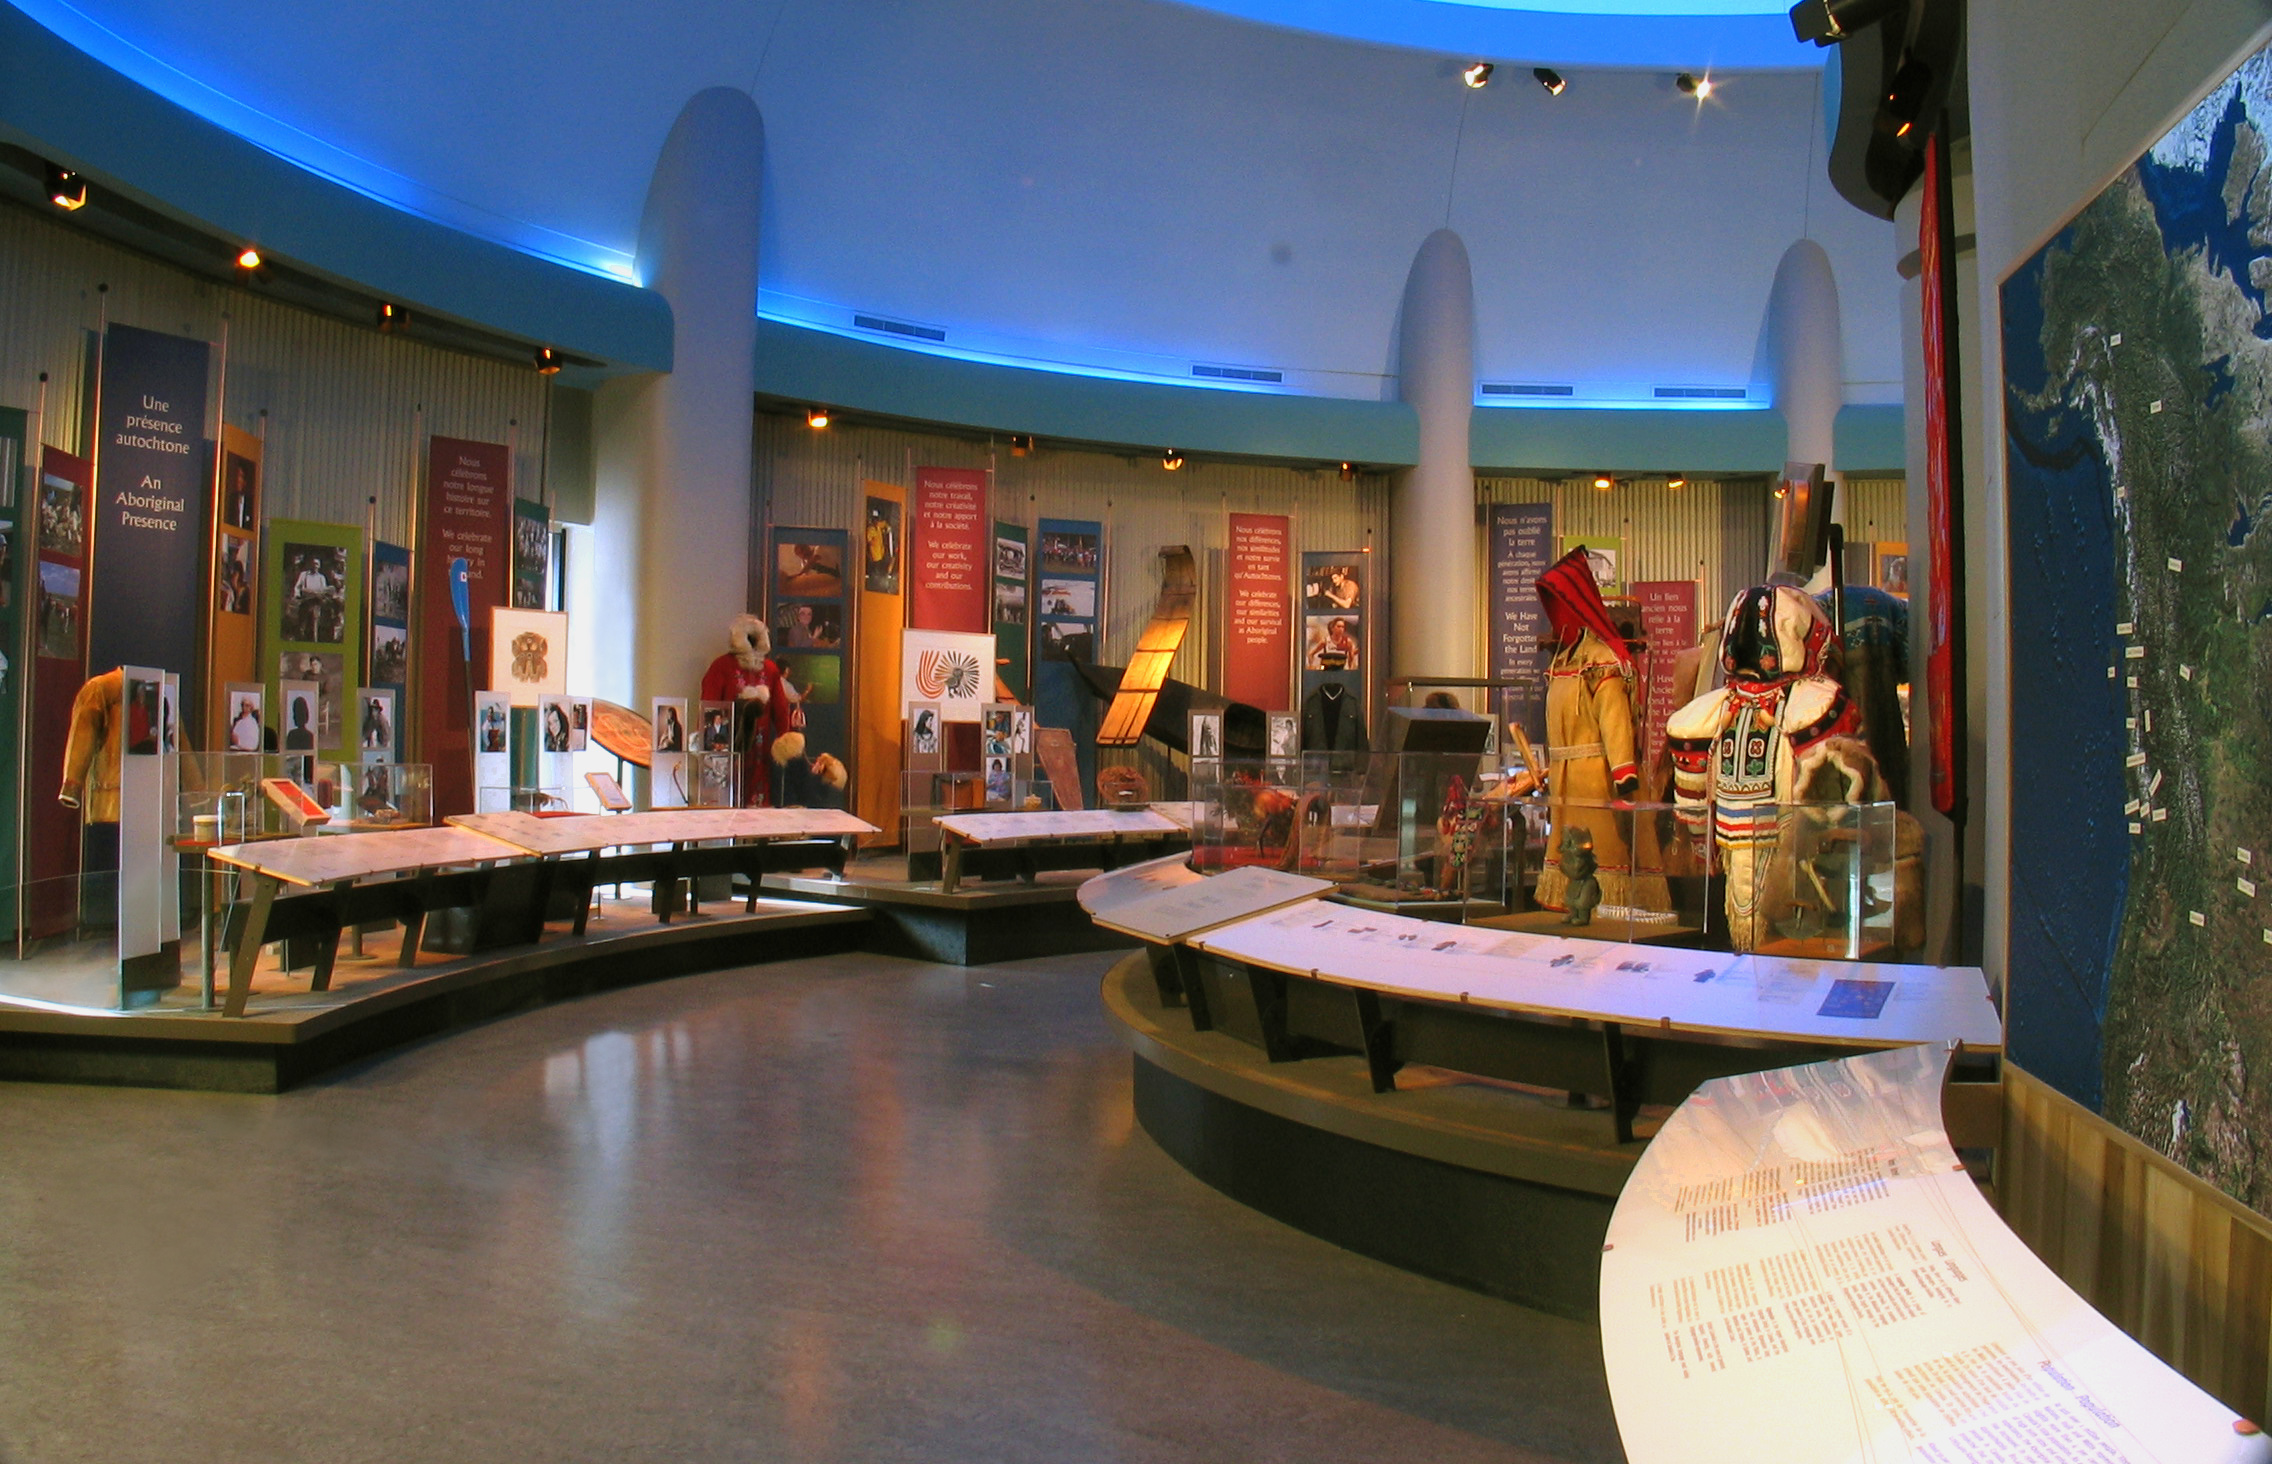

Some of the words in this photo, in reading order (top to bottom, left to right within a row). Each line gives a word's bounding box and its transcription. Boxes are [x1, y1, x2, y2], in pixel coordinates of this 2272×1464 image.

[143, 395, 170, 413] Une
[126, 415, 183, 434] présence
[116, 434, 190, 454] autochtone
[459, 456, 480, 467] Nous
[141, 475, 162, 489] An
[924, 480, 943, 489] Nous
[443, 481, 464, 490] notre
[467, 482, 494, 494] longue
[116, 492, 185, 512] Aboriginal
[446, 491, 473, 504] histoire
[443, 506, 452, 514] ce
[122, 511, 177, 531] Presence
[954, 513, 978, 521] apport
[1497, 516, 1518, 525] Nous
[936, 520, 943, 528] la
[1236, 526, 1253, 534] Nous
[442, 529, 454, 539] We
[456, 531, 492, 543] celebrate
[449, 544, 462, 552] our
[465, 544, 484, 556] long
[928, 540, 939, 549] We
[941, 540, 972, 550] celebrate
[941, 562, 972, 571] creativity
[936, 571, 949, 579] and
[1239, 590, 1250, 598] We
[1251, 591, 1278, 599] celebrate
[1650, 593, 1663, 602] Un
[1664, 592, 1679, 602] lien
[1641, 605, 1666, 613] ancien
[1668, 605, 1688, 613] nous
[1505, 612, 1518, 621] We
[1520, 612, 1538, 621] Have
[1673, 614, 1681, 623] la
[1514, 623, 1529, 633] Not
[1655, 627, 1674, 635] terre
[1505, 645, 1518, 653] the
[1520, 645, 1537, 653] Land
[2076, 1394, 2120, 1429] Population
